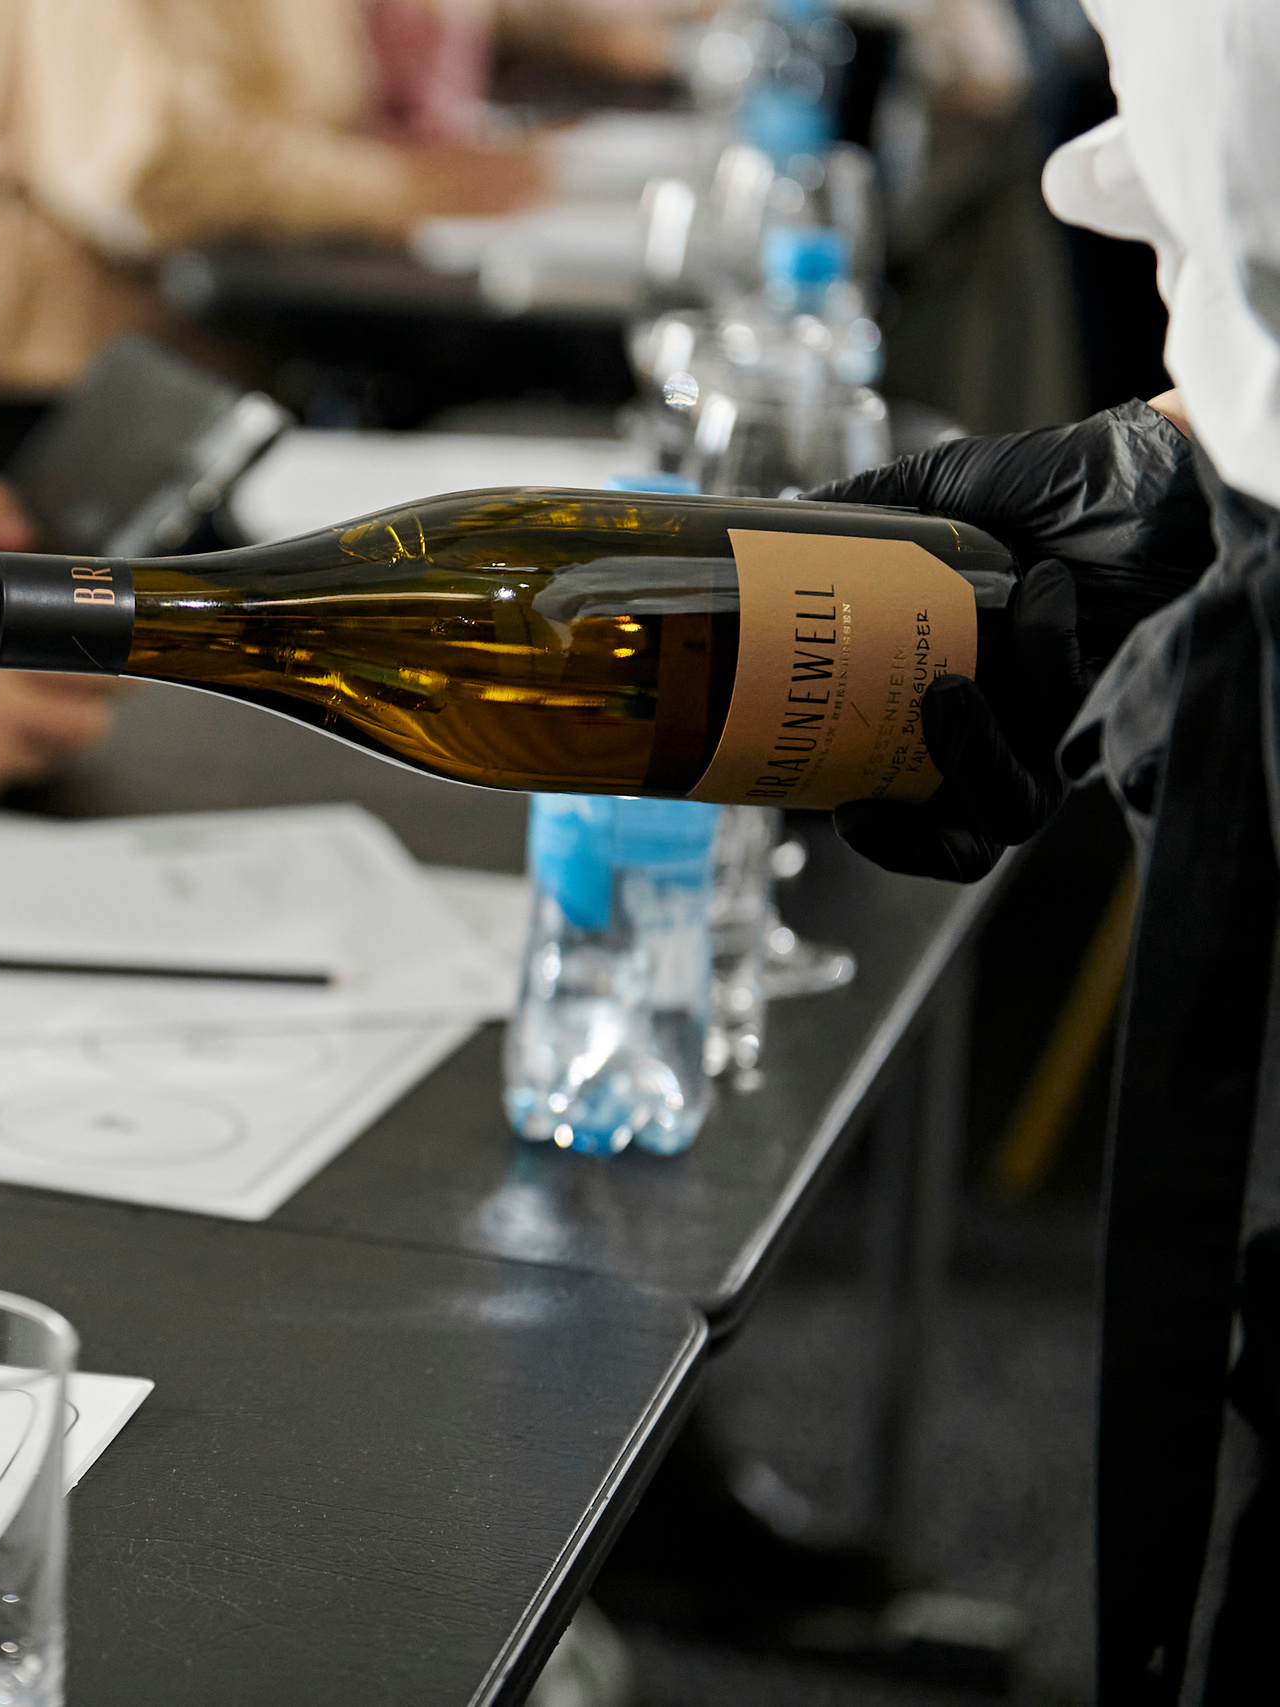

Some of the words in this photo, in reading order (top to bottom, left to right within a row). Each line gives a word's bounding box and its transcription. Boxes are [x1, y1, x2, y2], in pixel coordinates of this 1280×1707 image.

[71, 557, 115, 606] BR
[746, 584, 836, 798] BRAUNEWELL
[864, 644, 907, 776] ESSENHEIM
[902, 608, 931, 735] BURGUNDER
